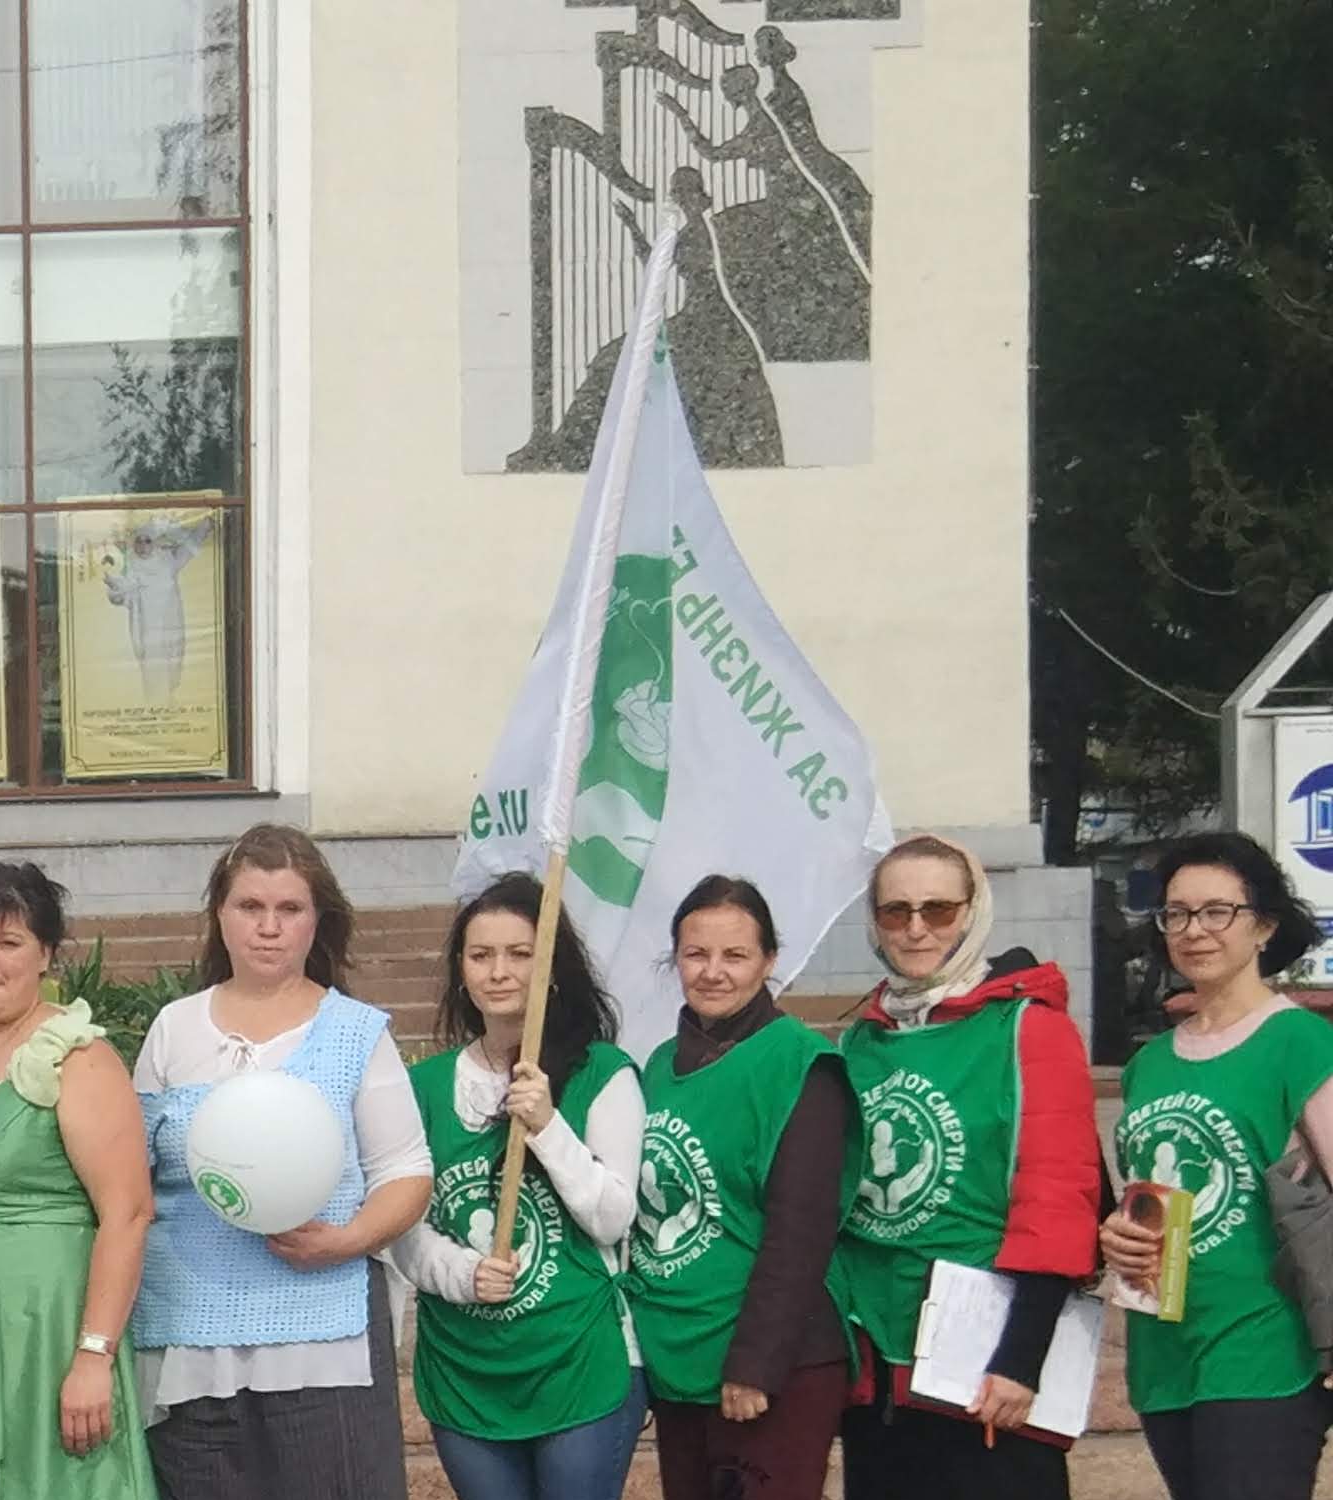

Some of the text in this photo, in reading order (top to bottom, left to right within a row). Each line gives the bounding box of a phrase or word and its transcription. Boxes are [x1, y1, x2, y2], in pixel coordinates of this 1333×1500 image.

[464, 788, 528, 841] e.ru
[668, 1117, 691, 1140] ОТ
[683, 1136, 723, 1217] СМЕРТИ
[904, 1073, 934, 1095] ОТ
[925, 1090, 966, 1172] СМЕРТИ
[1127, 1091, 1257, 1192] ДЕТЕЙ ОТ СМЕРТИ
